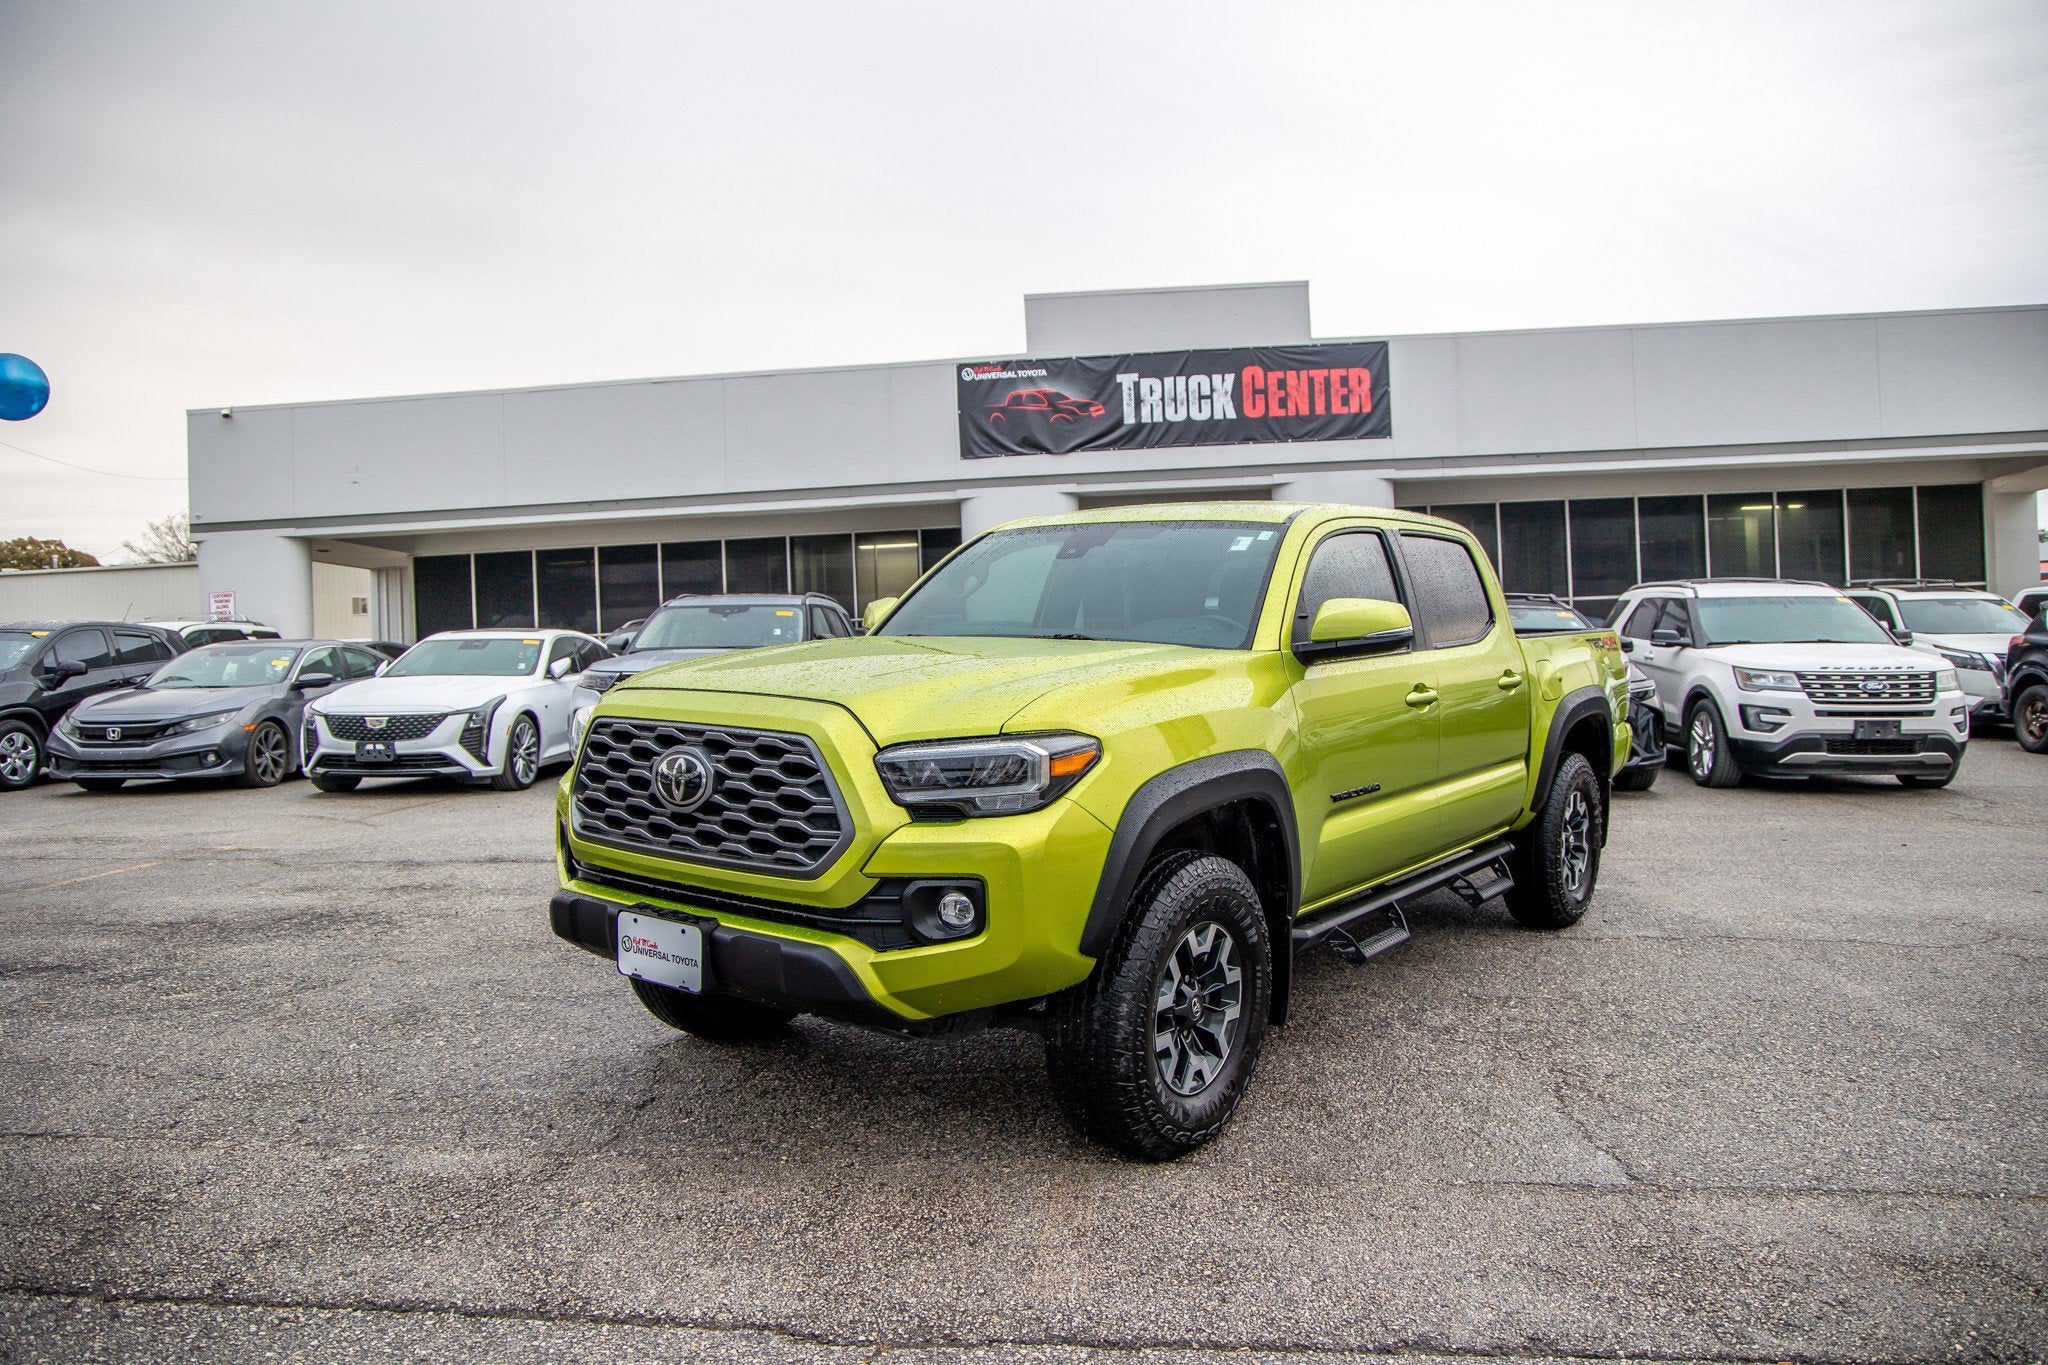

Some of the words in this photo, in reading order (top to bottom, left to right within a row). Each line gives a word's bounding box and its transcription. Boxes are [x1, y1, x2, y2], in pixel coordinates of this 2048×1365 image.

[974, 371, 1017, 380] UNIVERSAL
[1017, 369, 1048, 378] TOYOTA
[1116, 372, 1237, 425] TRUCK
[1241, 365, 1376, 418] CENTER
[632, 945, 670, 962] UNIVERSAL
[671, 954, 699, 968] TOYOTA
